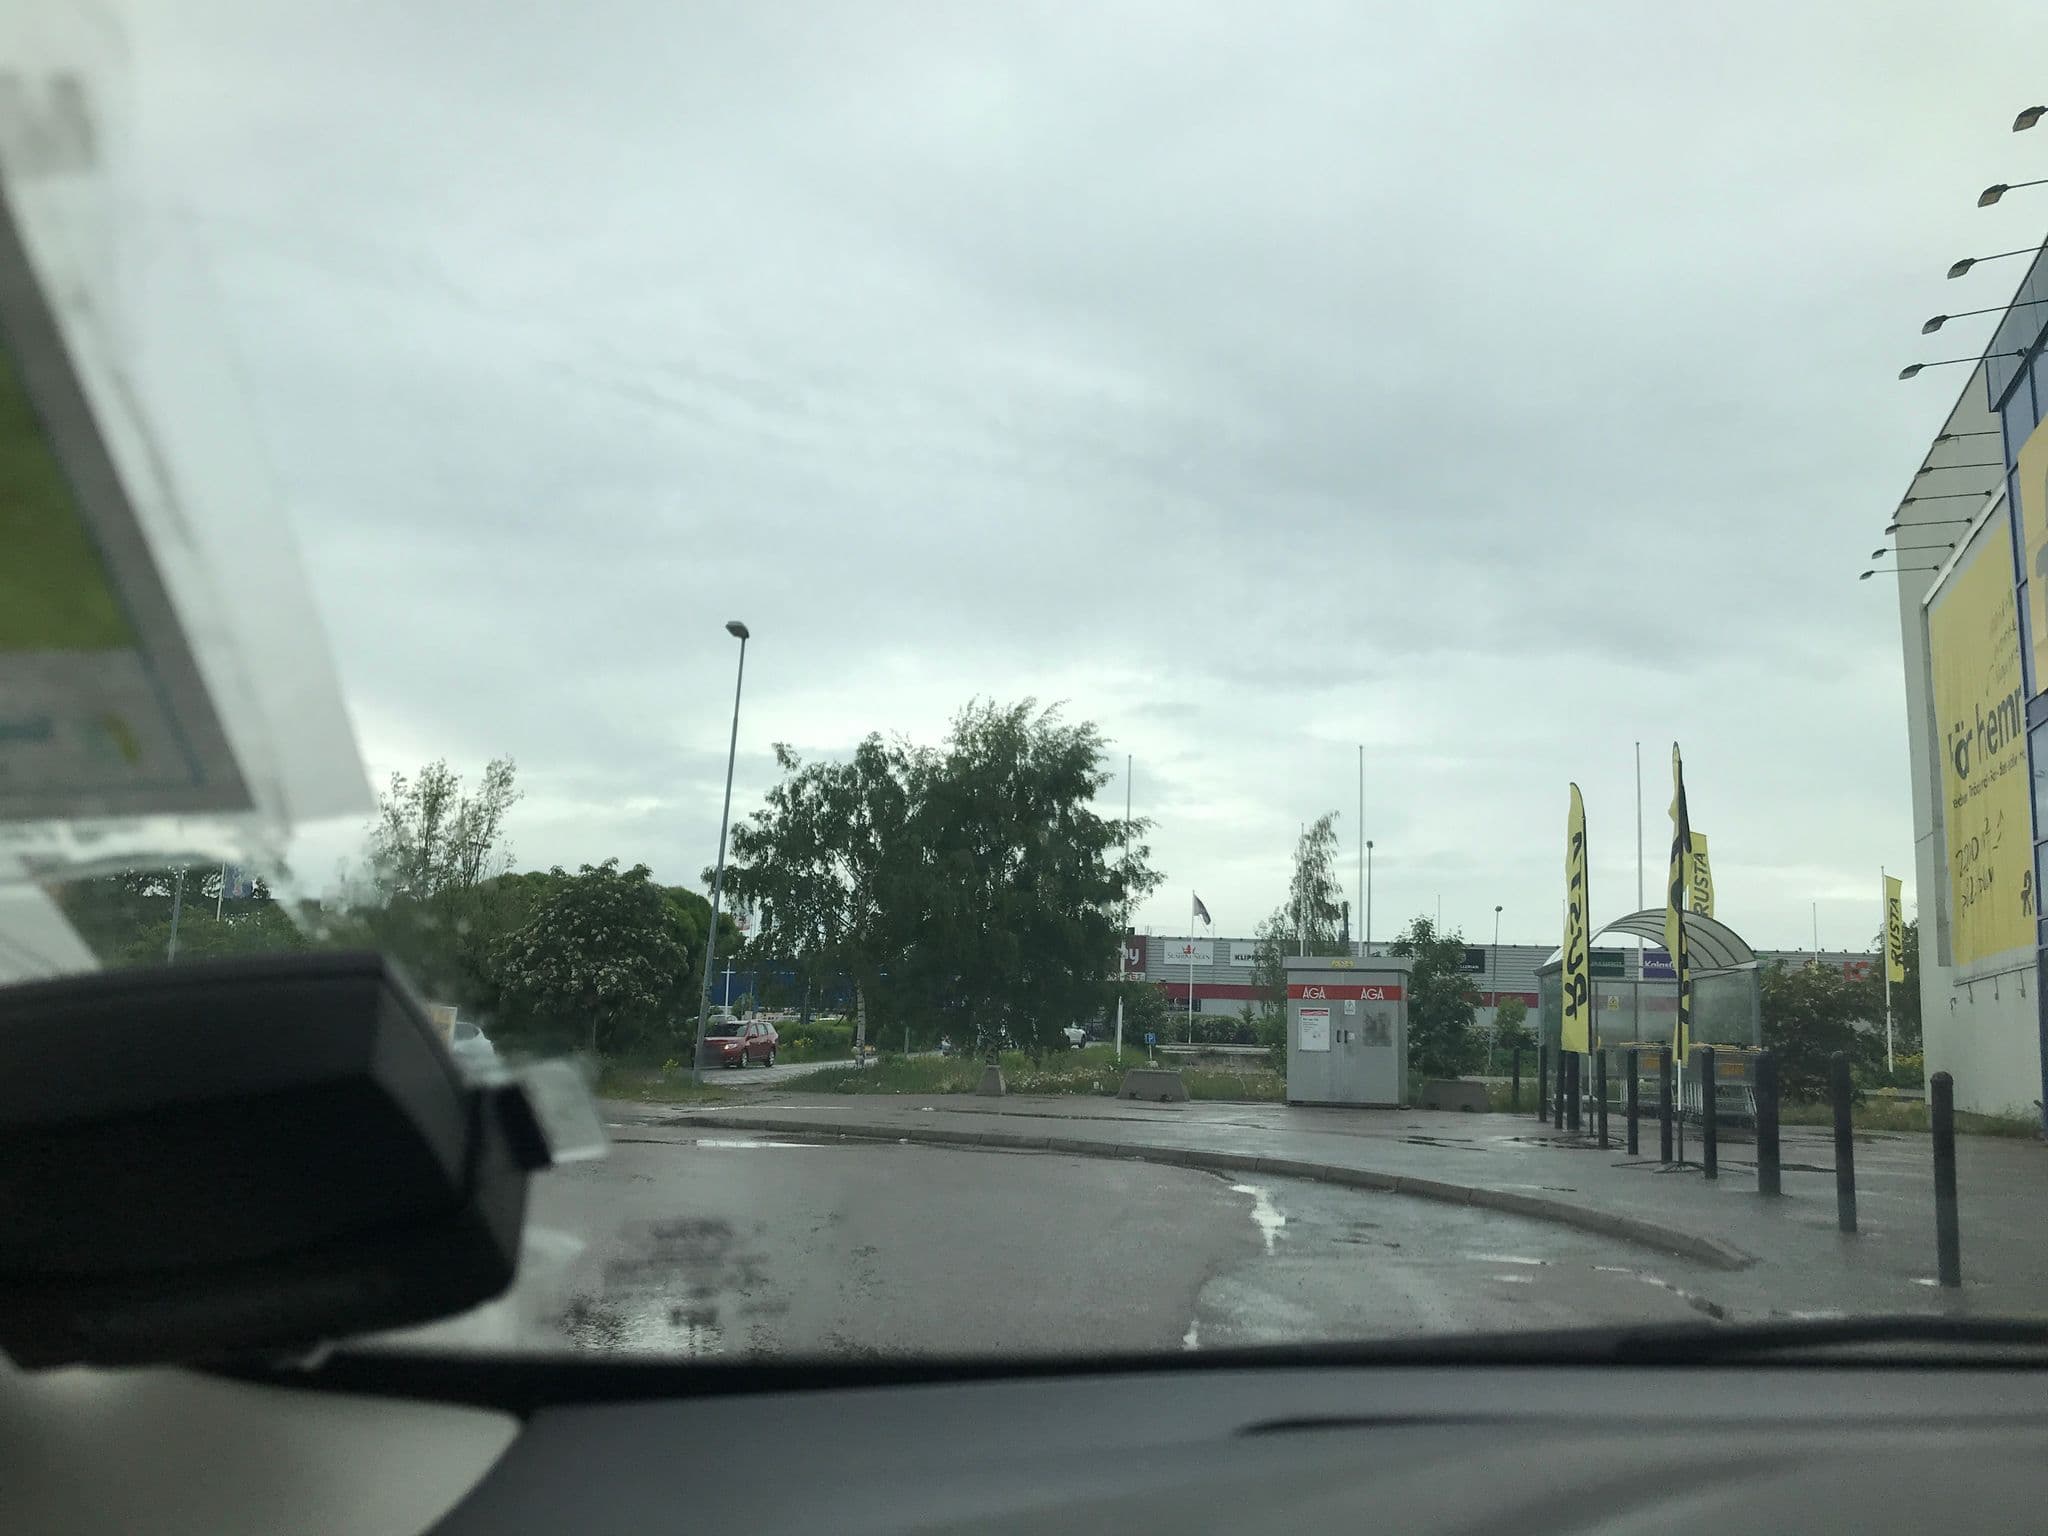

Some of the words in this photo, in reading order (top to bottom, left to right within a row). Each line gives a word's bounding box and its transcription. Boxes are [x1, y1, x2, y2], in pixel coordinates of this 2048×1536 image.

[1693, 852, 1709, 917] RUSTA
[1890, 897, 1904, 967] RUSTA
[1303, 986, 1326, 999] AGA
[1361, 987, 1384, 1000] AGA
